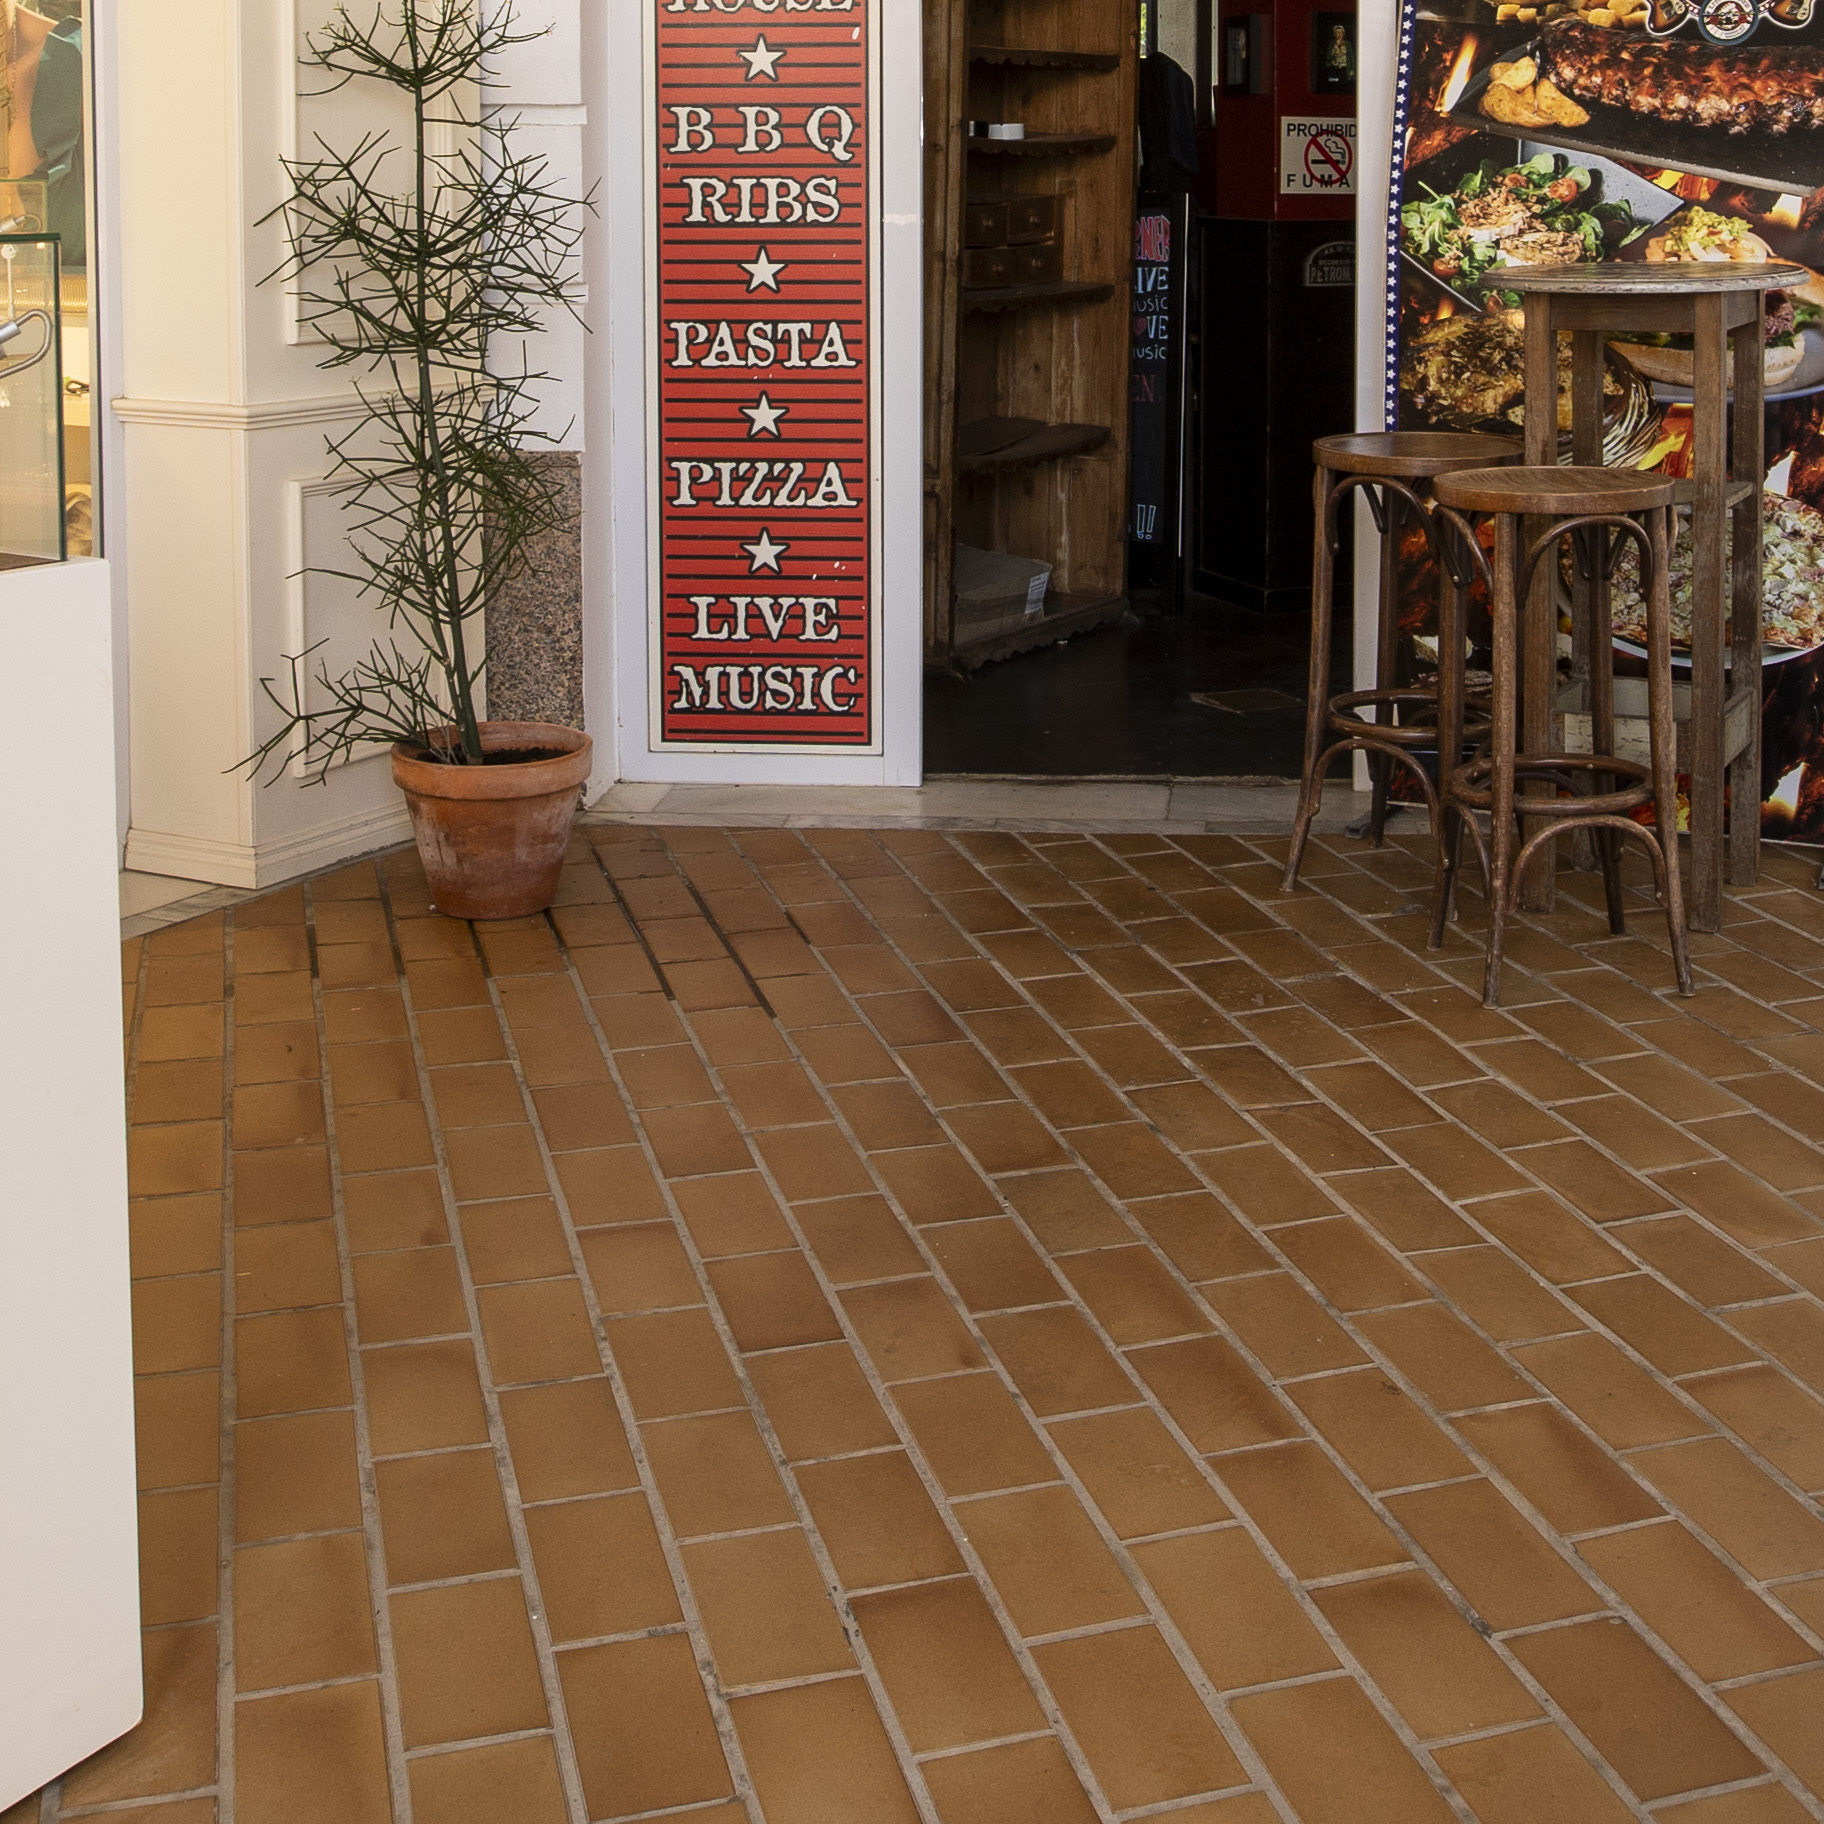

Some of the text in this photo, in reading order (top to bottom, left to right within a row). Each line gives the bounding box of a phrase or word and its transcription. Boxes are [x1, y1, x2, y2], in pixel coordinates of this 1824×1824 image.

[1287, 123, 1357, 138] PROHIBID
[684, 177, 839, 223] RIBS
[1134, 266, 1169, 294] IVE
[1134, 294, 1168, 313] usic
[669, 321, 857, 367] PASTA
[1133, 344, 1167, 359] usic
[670, 461, 858, 507] PIZZA
[689, 596, 838, 641] LIVE
[673, 666, 856, 711] MUSIC
